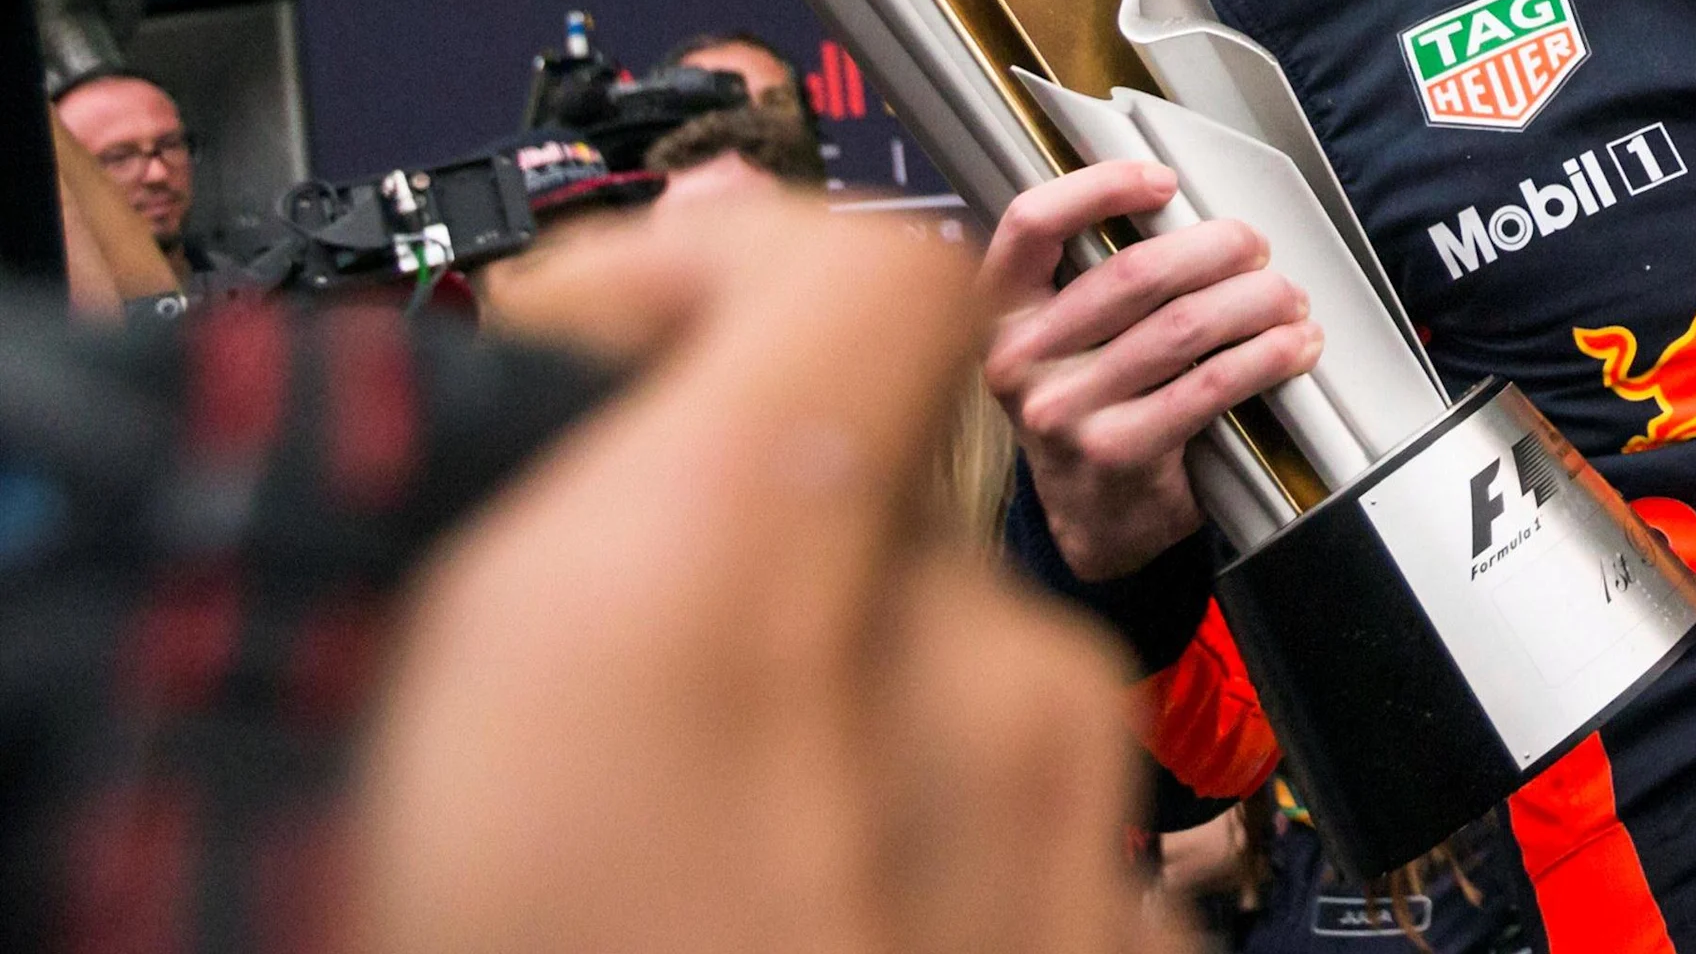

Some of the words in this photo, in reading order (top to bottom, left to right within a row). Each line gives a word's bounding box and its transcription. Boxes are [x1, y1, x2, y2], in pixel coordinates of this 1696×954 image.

[1430, 30, 1575, 119] HEUER
[1427, 150, 1616, 282] Mobil
[1626, 134, 1666, 184] 1
[1470, 430, 1560, 559] F1
[1471, 527, 1532, 581] Formula
